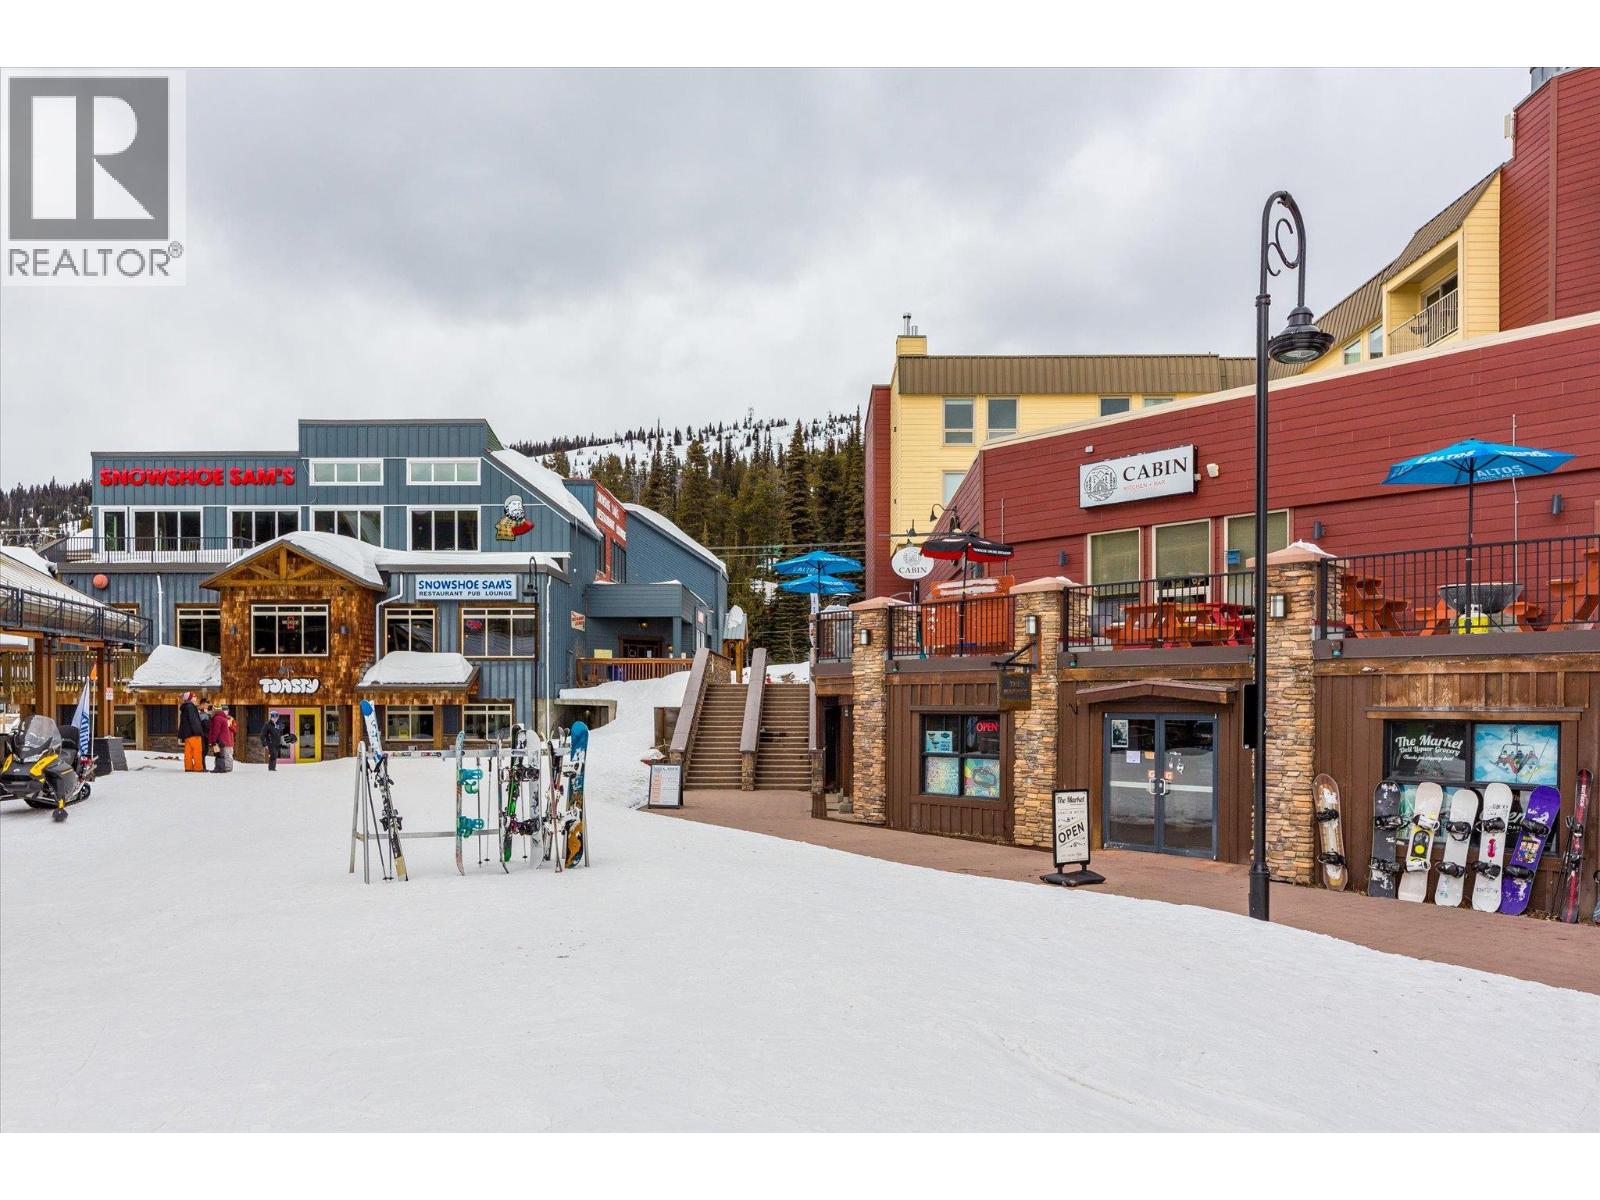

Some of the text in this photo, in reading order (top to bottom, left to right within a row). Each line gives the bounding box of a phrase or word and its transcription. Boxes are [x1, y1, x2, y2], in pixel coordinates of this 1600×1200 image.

[1123, 456, 1188, 482] CABIN
[1476, 464, 1523, 478] ALTOS
[99, 466, 296, 487] SNOWSHOE SAM'S
[898, 566, 928, 575] CABIN
[418, 579, 512, 590] SNOWSHOE SAM'S
[259, 677, 320, 694] TOASTY
[975, 722, 999, 732] OPEN
[1395, 734, 1464, 750] The Market
[1399, 746, 1461, 757] Deli Liquor Grocery
[1057, 795, 1086, 804] The Market
[1058, 821, 1086, 844] OPEN
